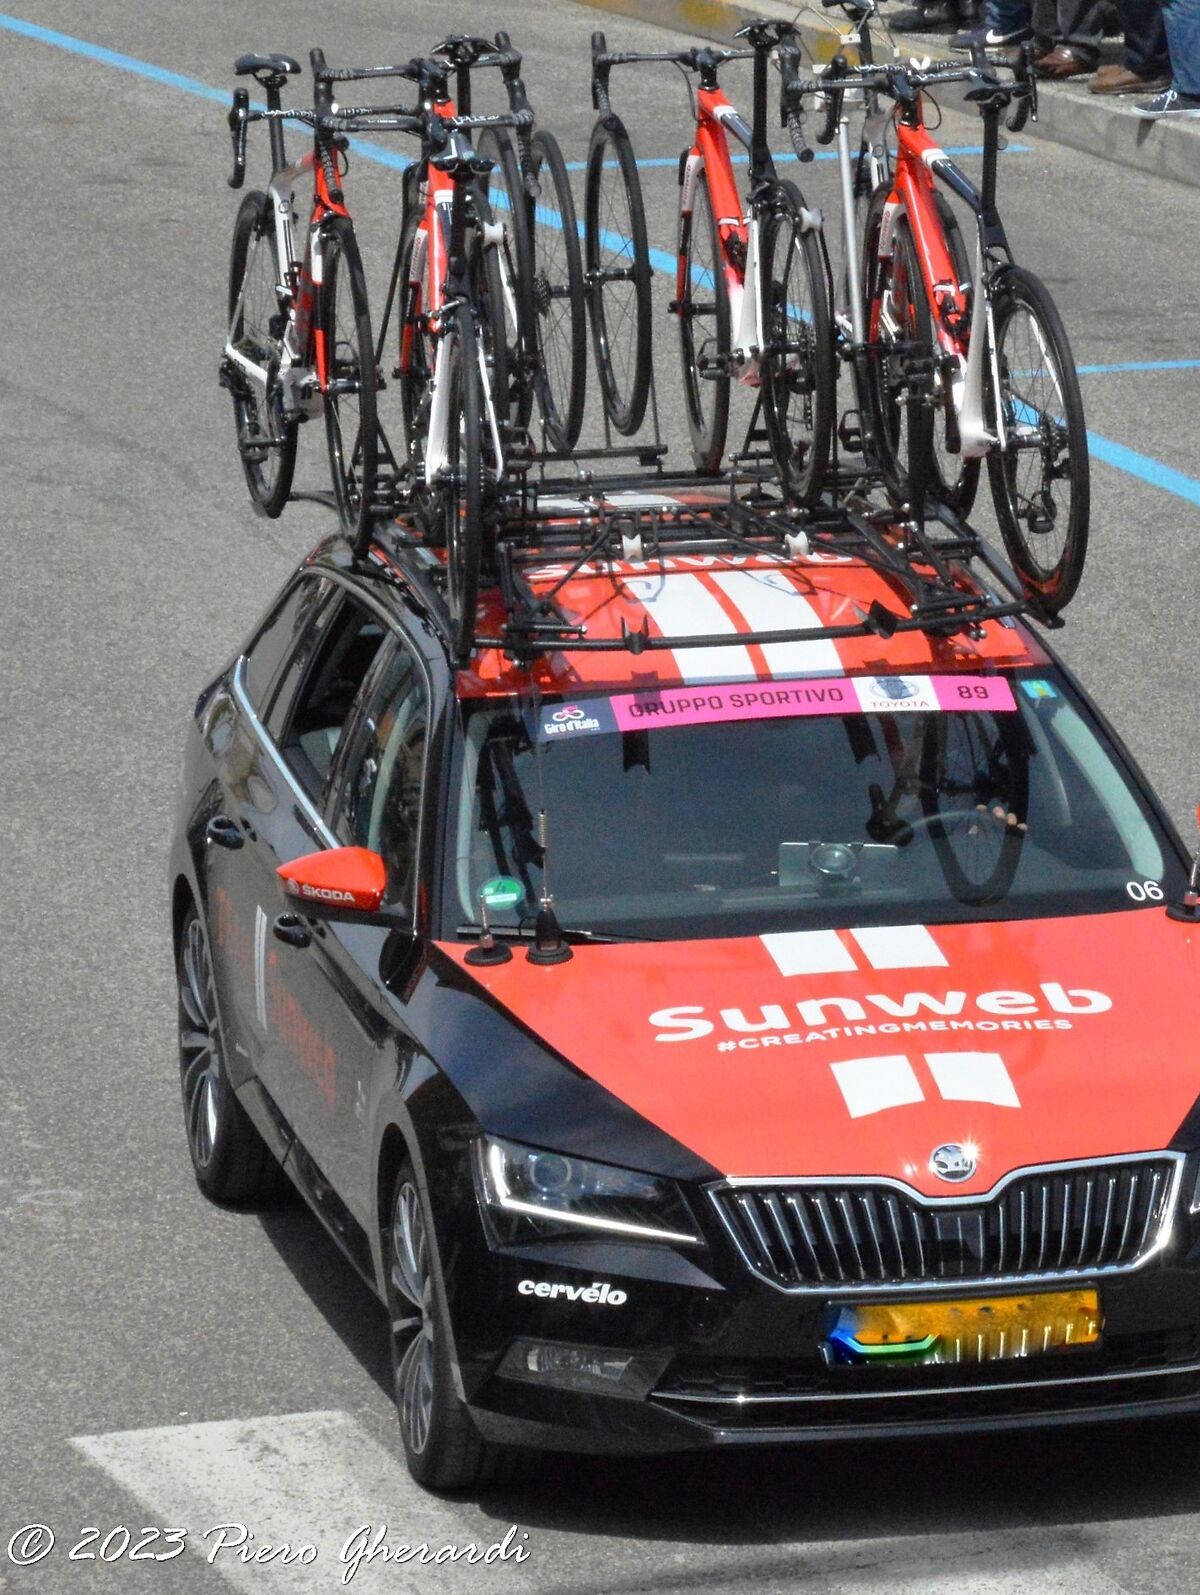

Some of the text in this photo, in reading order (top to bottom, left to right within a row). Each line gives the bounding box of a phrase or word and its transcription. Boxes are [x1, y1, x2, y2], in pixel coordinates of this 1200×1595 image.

[628, 687, 844, 718] GRUPPO SPORTIVO
[871, 700, 930, 708] TOYOTA
[957, 685, 989, 699] 89
[544, 722, 567, 734] Giro
[1126, 880, 1164, 901] 06
[648, 982, 1113, 1042] Sunweb
[716, 1018, 1073, 1052] #CREATINGMEMORIES
[517, 1279, 627, 1306] cervélo
